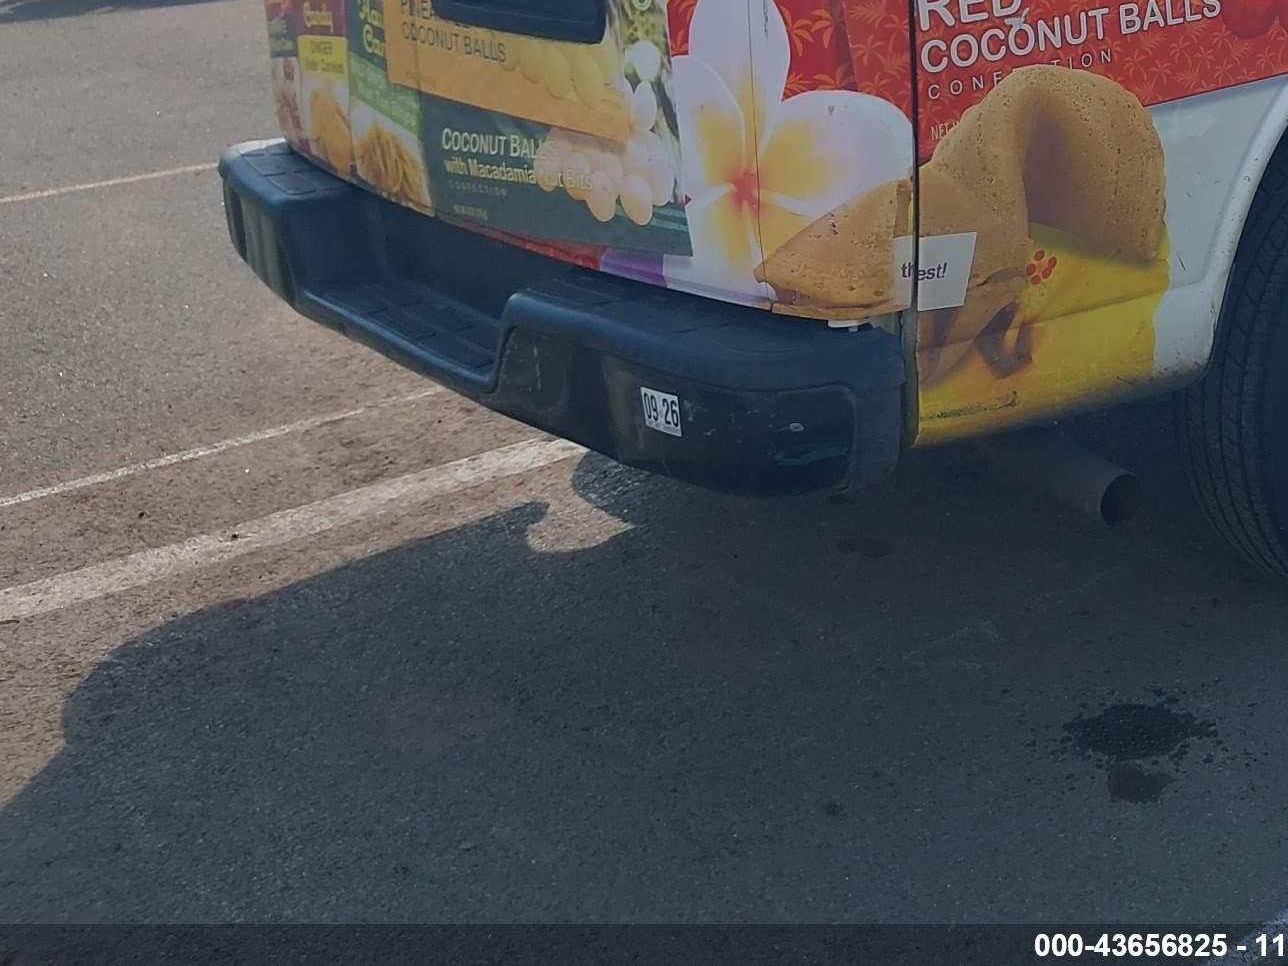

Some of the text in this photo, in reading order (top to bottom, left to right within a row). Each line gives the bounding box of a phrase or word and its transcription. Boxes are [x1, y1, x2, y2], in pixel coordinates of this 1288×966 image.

[402, 21, 507, 63] COCONUT BALLS
[920, 8, 1109, 74] COCONUT
[442, 128, 506, 155] COCONUT
[444, 156, 468, 176] with
[468, 159, 536, 184] Macadamia
[643, 392, 679, 428] 09 26
